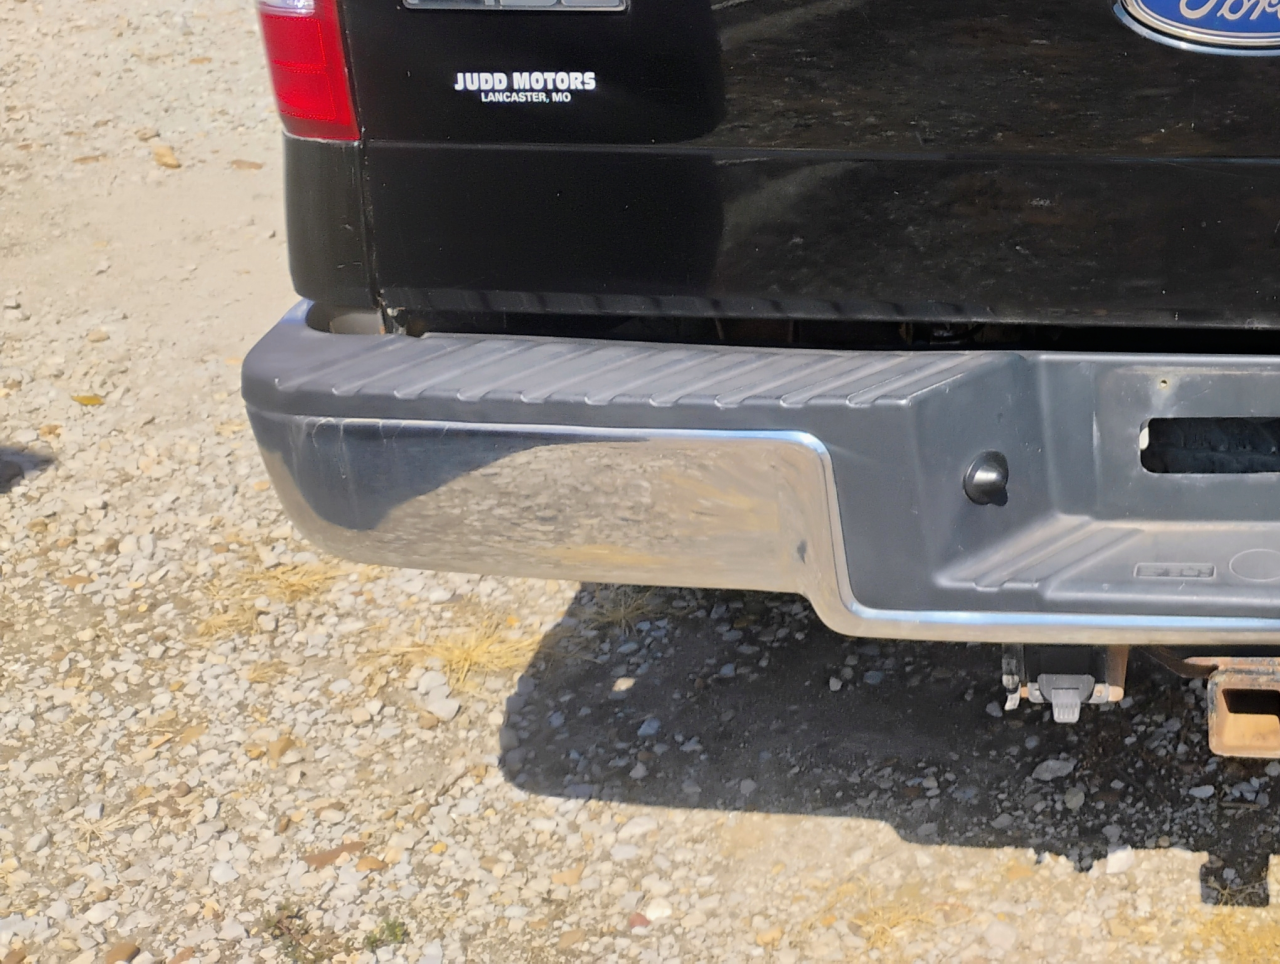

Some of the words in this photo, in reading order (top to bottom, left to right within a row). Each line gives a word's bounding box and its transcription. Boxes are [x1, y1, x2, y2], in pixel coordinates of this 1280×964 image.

[454, 72, 508, 91] JUDD
[512, 72, 596, 90] MOTORS
[481, 92, 550, 103] LANCASTER,
[552, 92, 571, 103] MO
